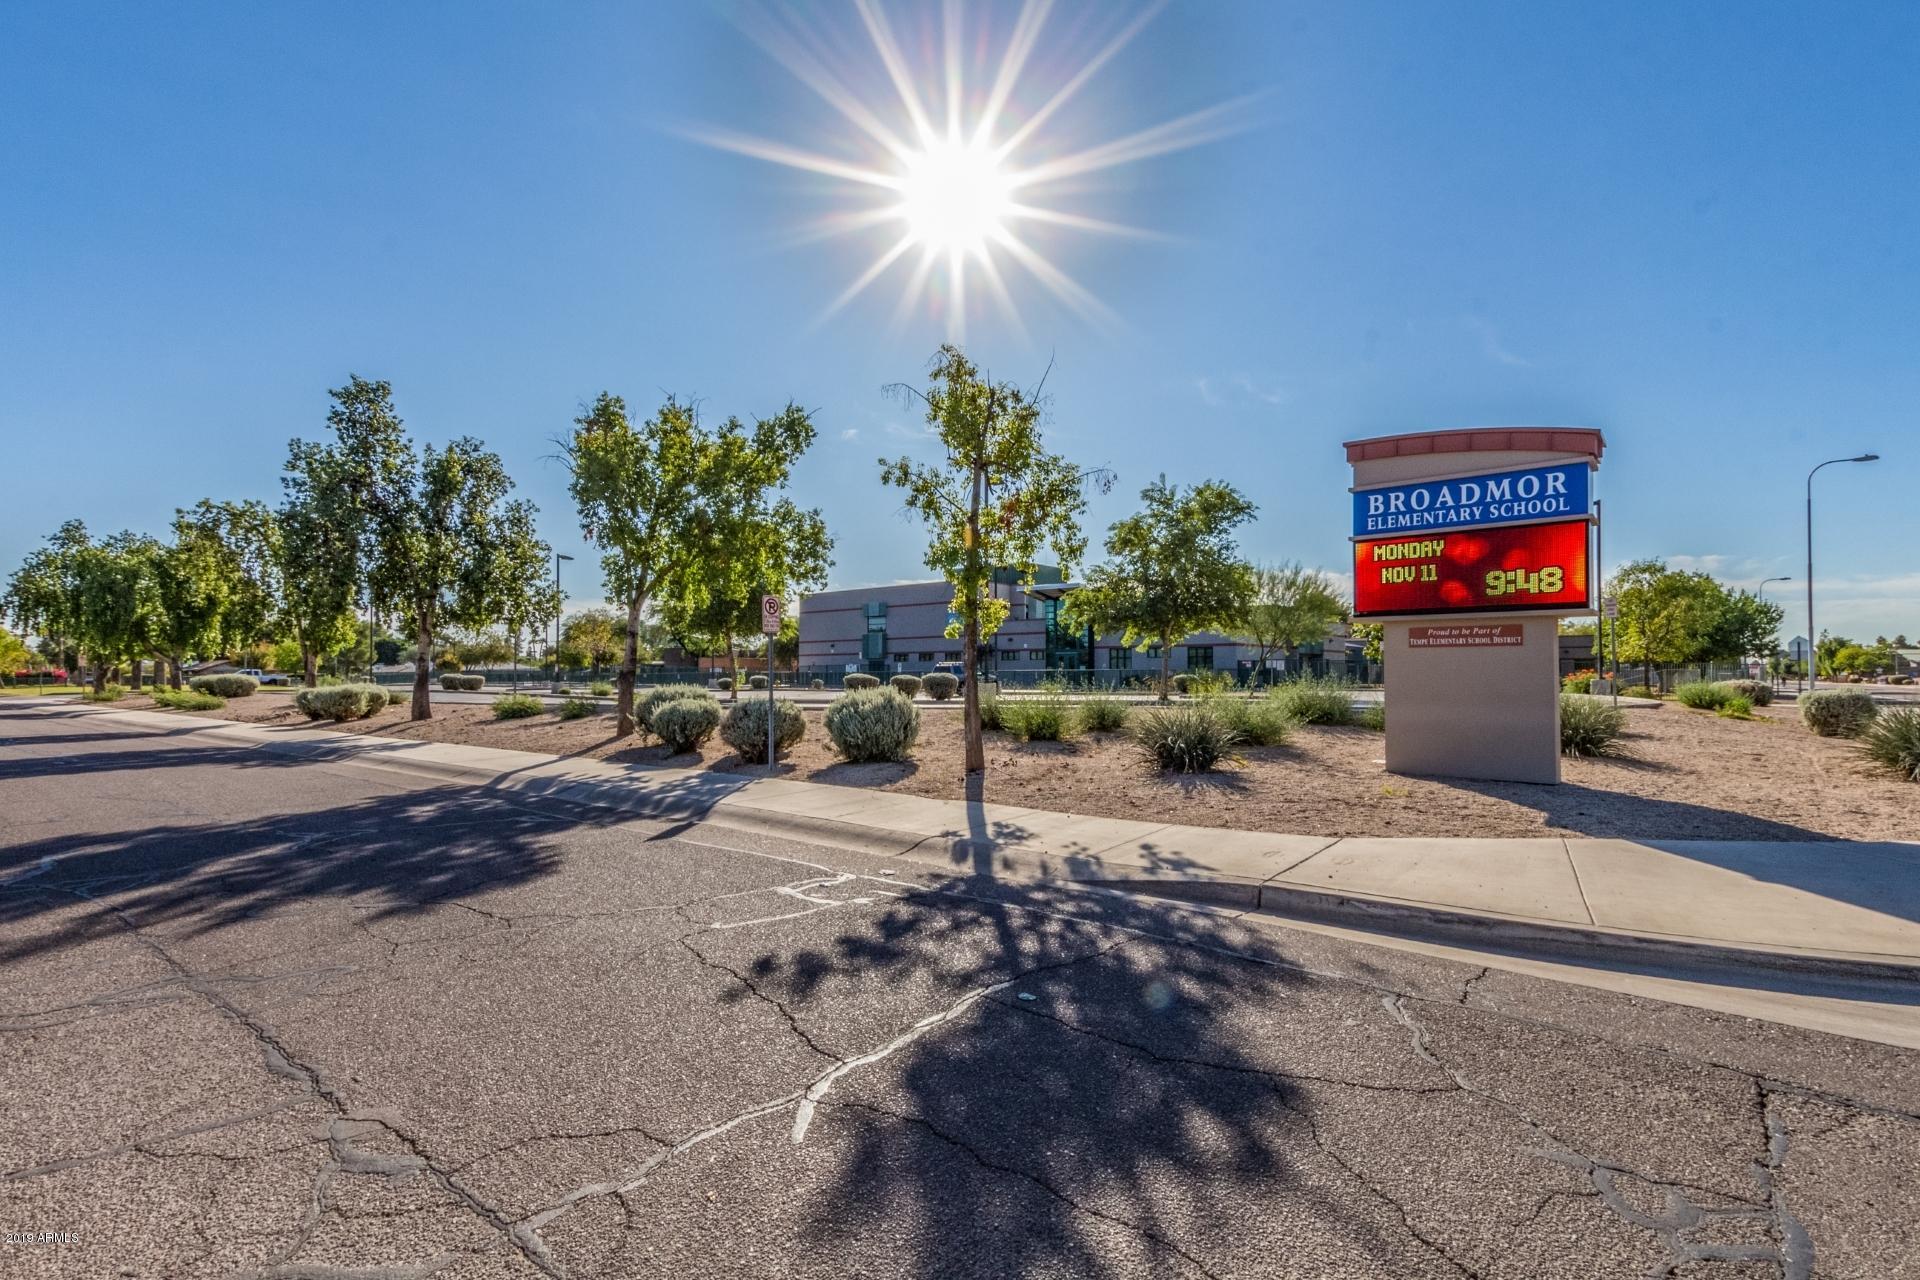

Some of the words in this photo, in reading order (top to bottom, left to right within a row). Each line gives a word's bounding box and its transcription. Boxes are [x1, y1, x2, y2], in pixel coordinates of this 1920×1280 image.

[1367, 472, 1568, 515] BROADMOR
[1367, 506, 1483, 530] ELEMENTARY
[1489, 497, 1570, 518] SCHOOL
[1373, 540, 1445, 562] MONDAY
[1381, 565, 1416, 584] NOV
[1420, 564, 1438, 582] 11
[1485, 566, 1564, 596] 9:48
[1428, 628, 1450, 636] Proud
[1461, 627, 1471, 635] be
[1492, 627, 1502, 635] of
[1429, 637, 1466, 645] ELEMENTARY
[1468, 636, 1491, 644] SCHOOL
[1493, 636, 1521, 644] DISTRICT
